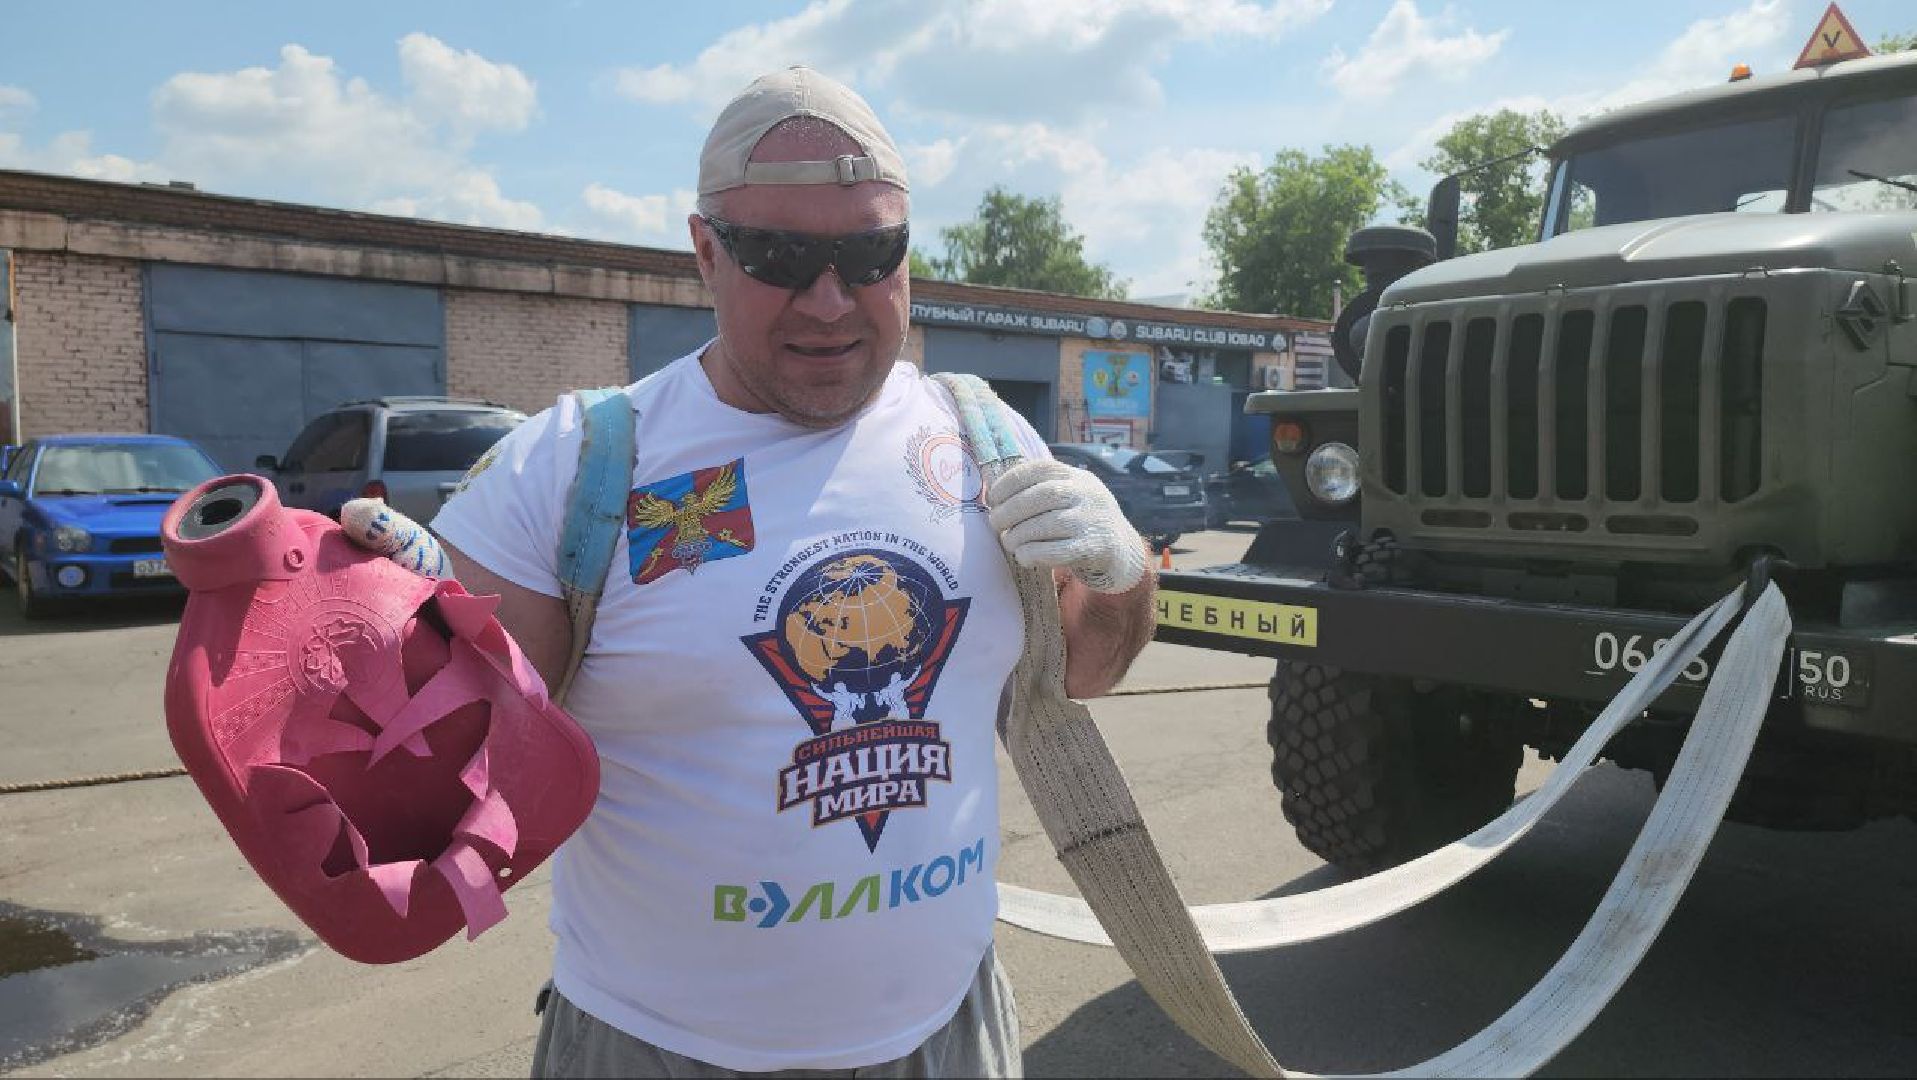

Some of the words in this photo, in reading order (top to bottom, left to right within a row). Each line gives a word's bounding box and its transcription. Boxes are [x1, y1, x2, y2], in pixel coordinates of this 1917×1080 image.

[912, 304, 974, 322] ЛУБНЫЙ
[976, 310, 1027, 327] ГАРАЖ
[1030, 316, 1085, 333] SUBARU
[1136, 325, 1191, 341] SUBARU
[1195, 330, 1226, 344] CLUB
[753, 595, 772, 622] THE
[765, 539, 829, 594] STRONGEST
[831, 530, 882, 546] NATION
[885, 532, 898, 544] IN
[903, 537, 928, 555] THE
[927, 551, 958, 590] WORLD
[1158, 600, 1305, 638] ЧЕБНЫЙ
[1800, 651, 1850, 687] 50
[1805, 685, 1841, 699] RUS
[799, 725, 937, 760] СИЛЬНЕЙШАЯ
[785, 743, 947, 804] НАЦИЯ
[819, 779, 922, 820] МИРА
